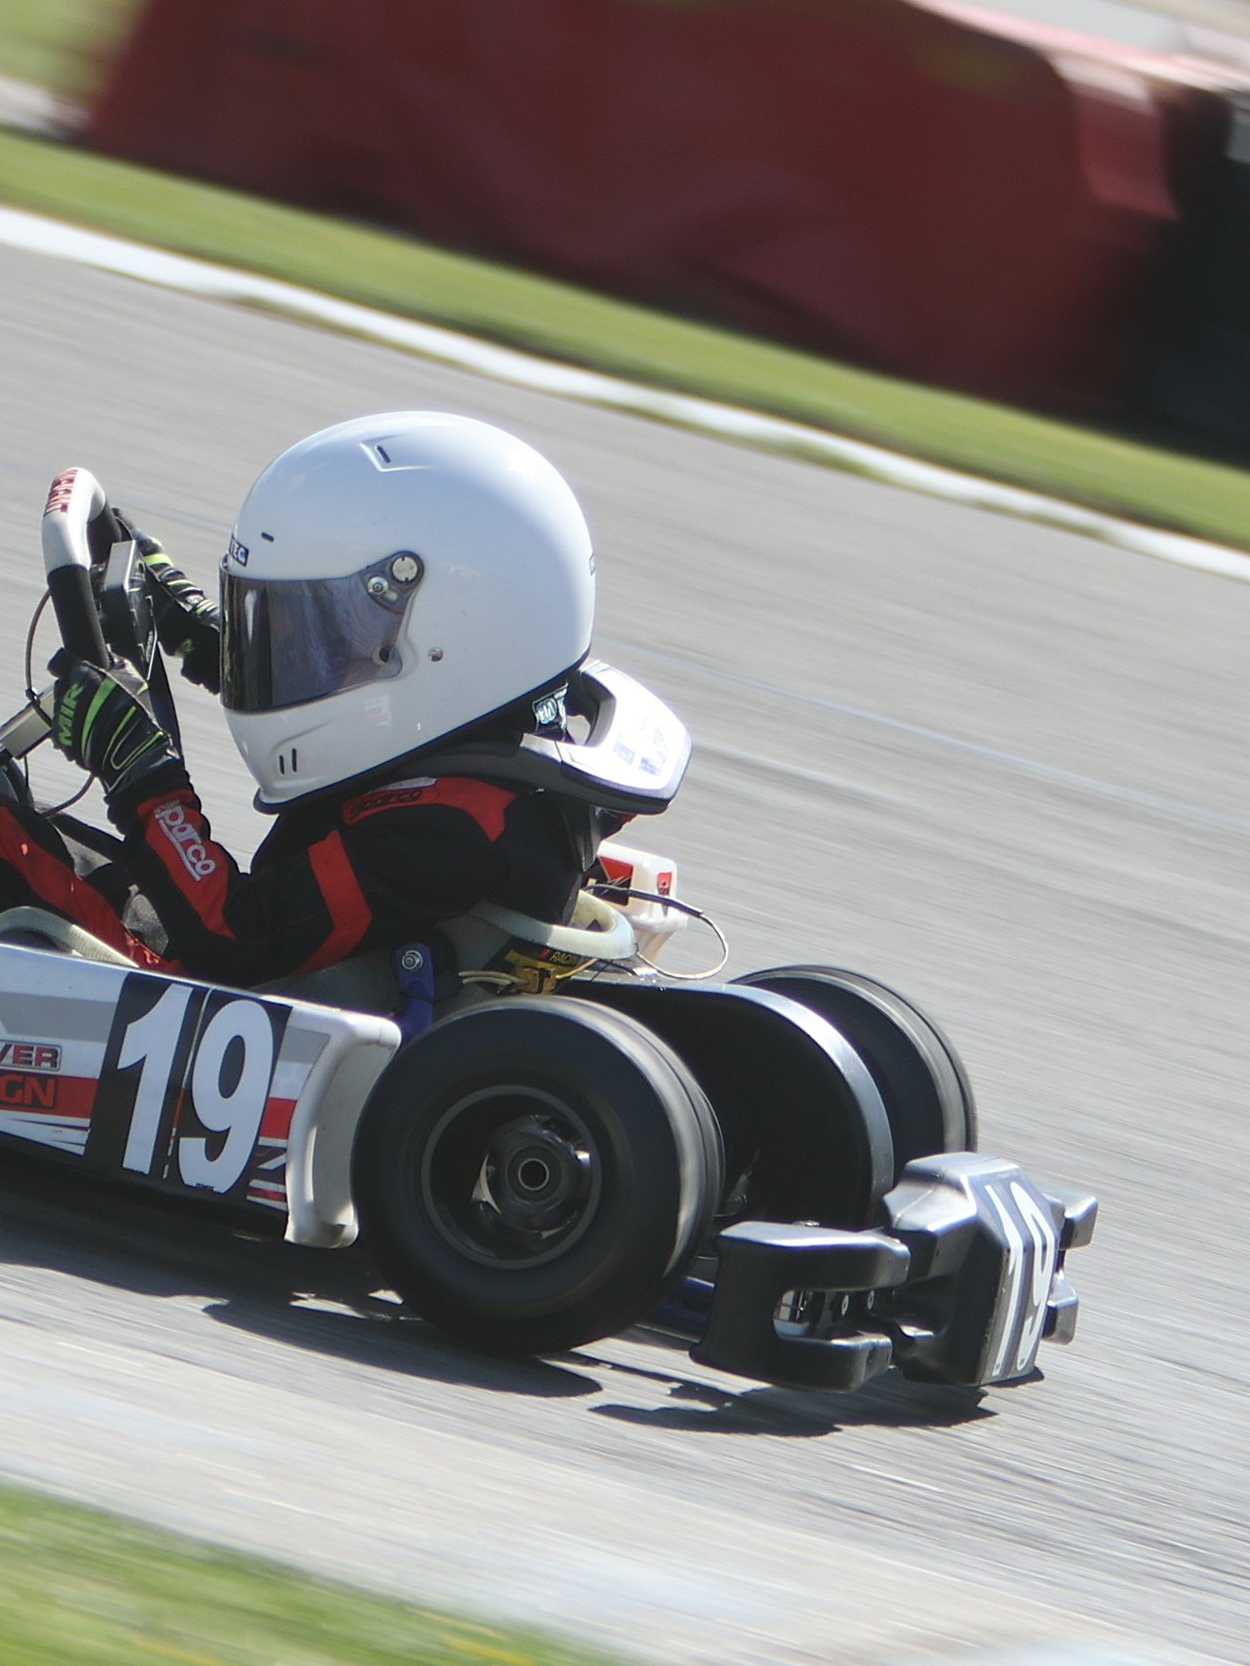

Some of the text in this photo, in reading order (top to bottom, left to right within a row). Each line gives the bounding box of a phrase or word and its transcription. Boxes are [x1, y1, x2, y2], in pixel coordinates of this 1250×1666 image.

[58, 683, 84, 747] MIR
[154, 799, 216, 881] parco
[117, 983, 274, 1194] 19
[992, 1182, 1055, 1377] 19
